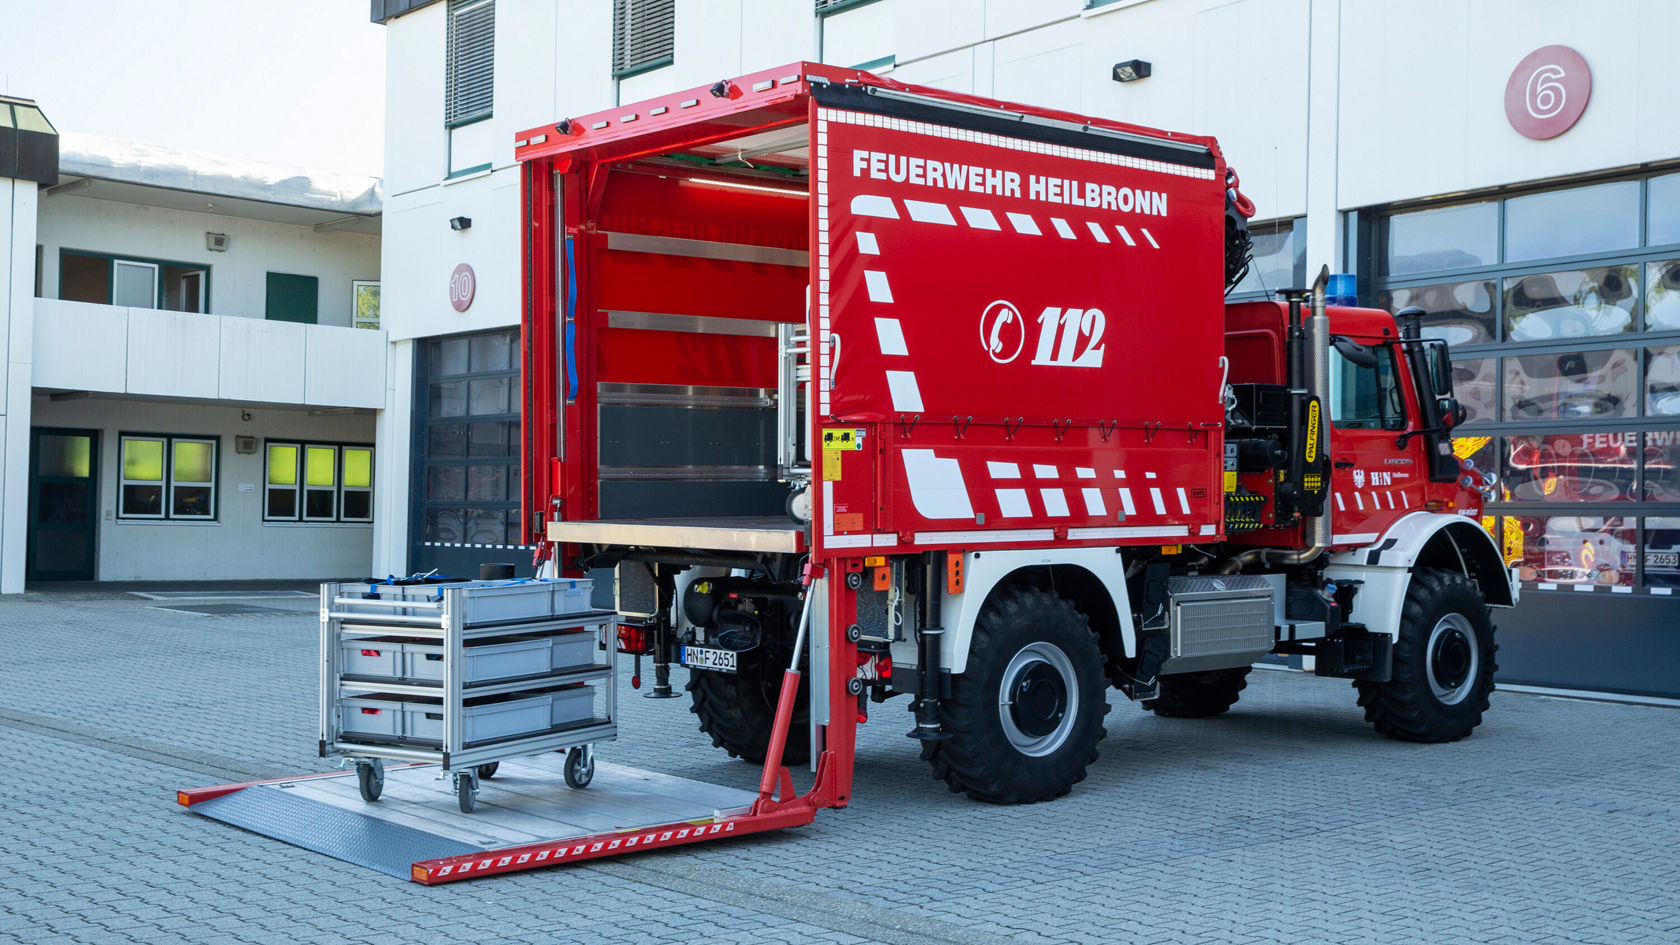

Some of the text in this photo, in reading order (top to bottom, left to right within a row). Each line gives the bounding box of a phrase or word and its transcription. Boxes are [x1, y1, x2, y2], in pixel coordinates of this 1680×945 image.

[1526, 64, 1566, 119] 6
[853, 149, 1168, 217] FEUERWEHR HEILBRONN
[450, 271, 472, 302] 10
[1031, 306, 1106, 368] 112
[1307, 404, 1318, 459] PALFINGER
[1653, 554, 1677, 565] 2653
[686, 647, 736, 668] HN F 2651
